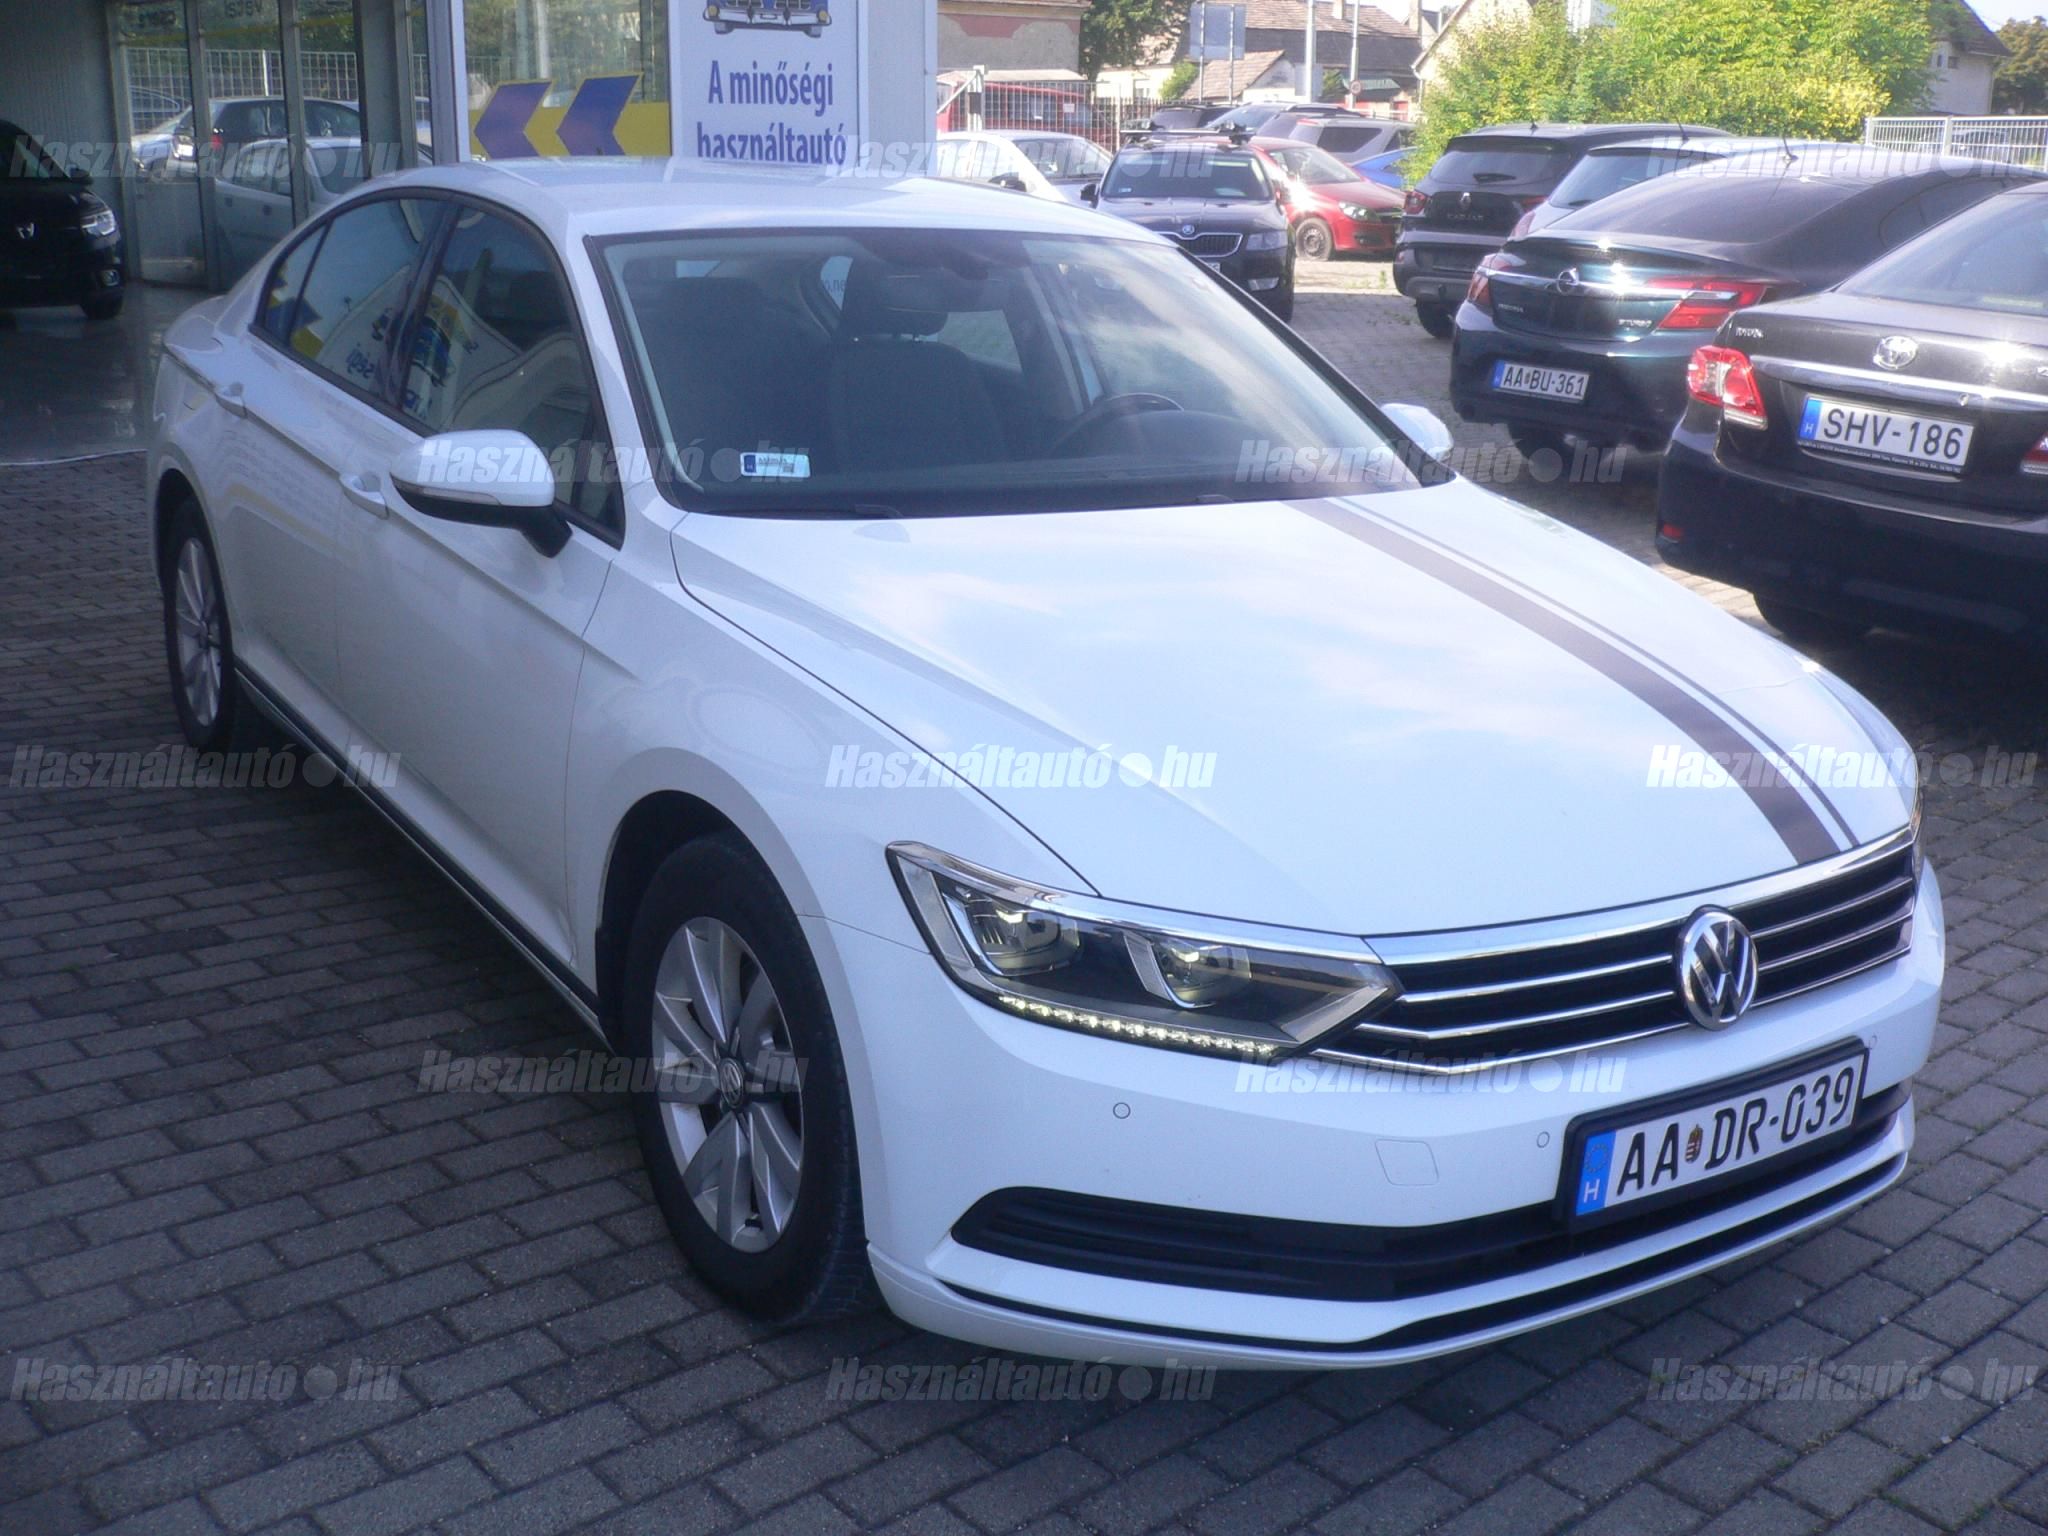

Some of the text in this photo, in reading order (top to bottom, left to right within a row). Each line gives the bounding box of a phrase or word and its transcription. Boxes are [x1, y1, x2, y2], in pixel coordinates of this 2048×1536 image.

[708, 60, 833, 117] A minőségi
[697, 121, 847, 165] használtautó
[1530, 370, 1585, 396] BU-361
[1824, 408, 1964, 459] SHV-186
[1617, 1066, 1854, 1196] AA DR-039
[1583, 1178, 1600, 1203] H
